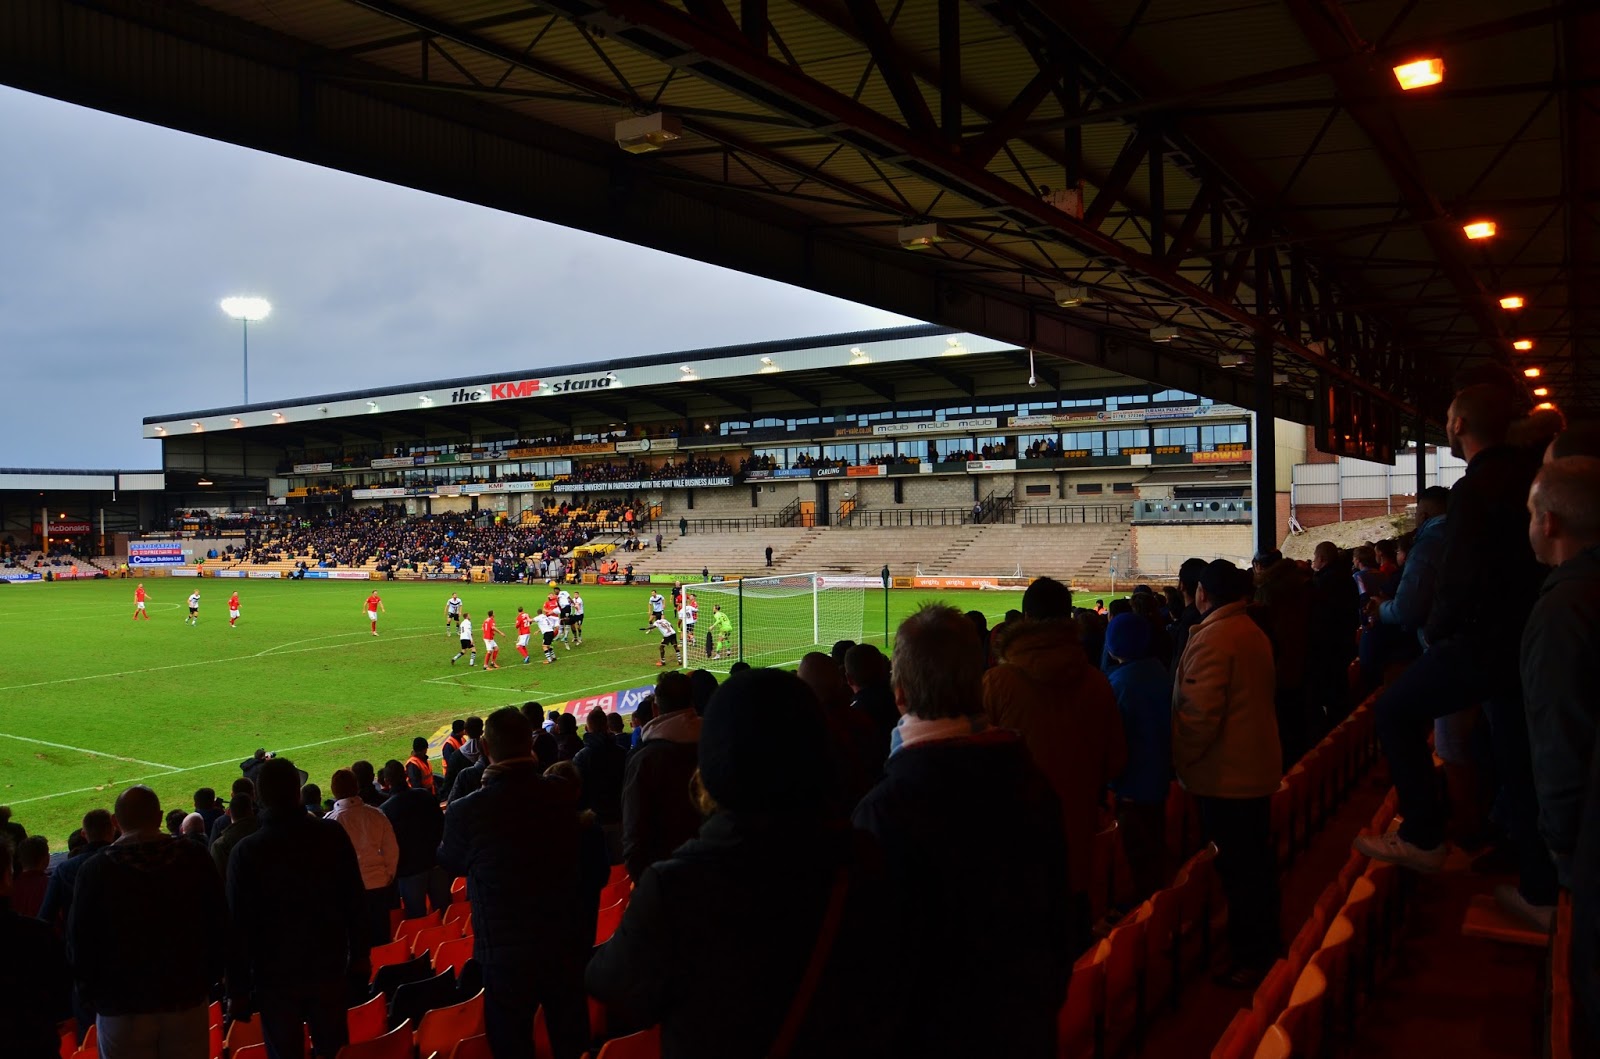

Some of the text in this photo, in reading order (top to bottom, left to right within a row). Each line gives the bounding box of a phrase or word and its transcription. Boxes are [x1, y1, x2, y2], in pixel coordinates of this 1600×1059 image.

[452, 372, 612, 403] the KMF stand
[816, 467, 840, 477] CARLING
[554, 483, 584, 492] STAFFORDSHIRE
[584, 482, 607, 491] UNIVERSITY
[613, 481, 641, 490] PARTNERSHIP
[641, 481, 652, 489] WITH
[652, 480, 661, 488] THE
[661, 479, 673, 488] PORT
[673, 479, 684, 487] VALE
[685, 478, 707, 487] BUSINESS
[708, 477, 730, 486] ALLIANCE
[48, 524, 90, 532] McDonald's
